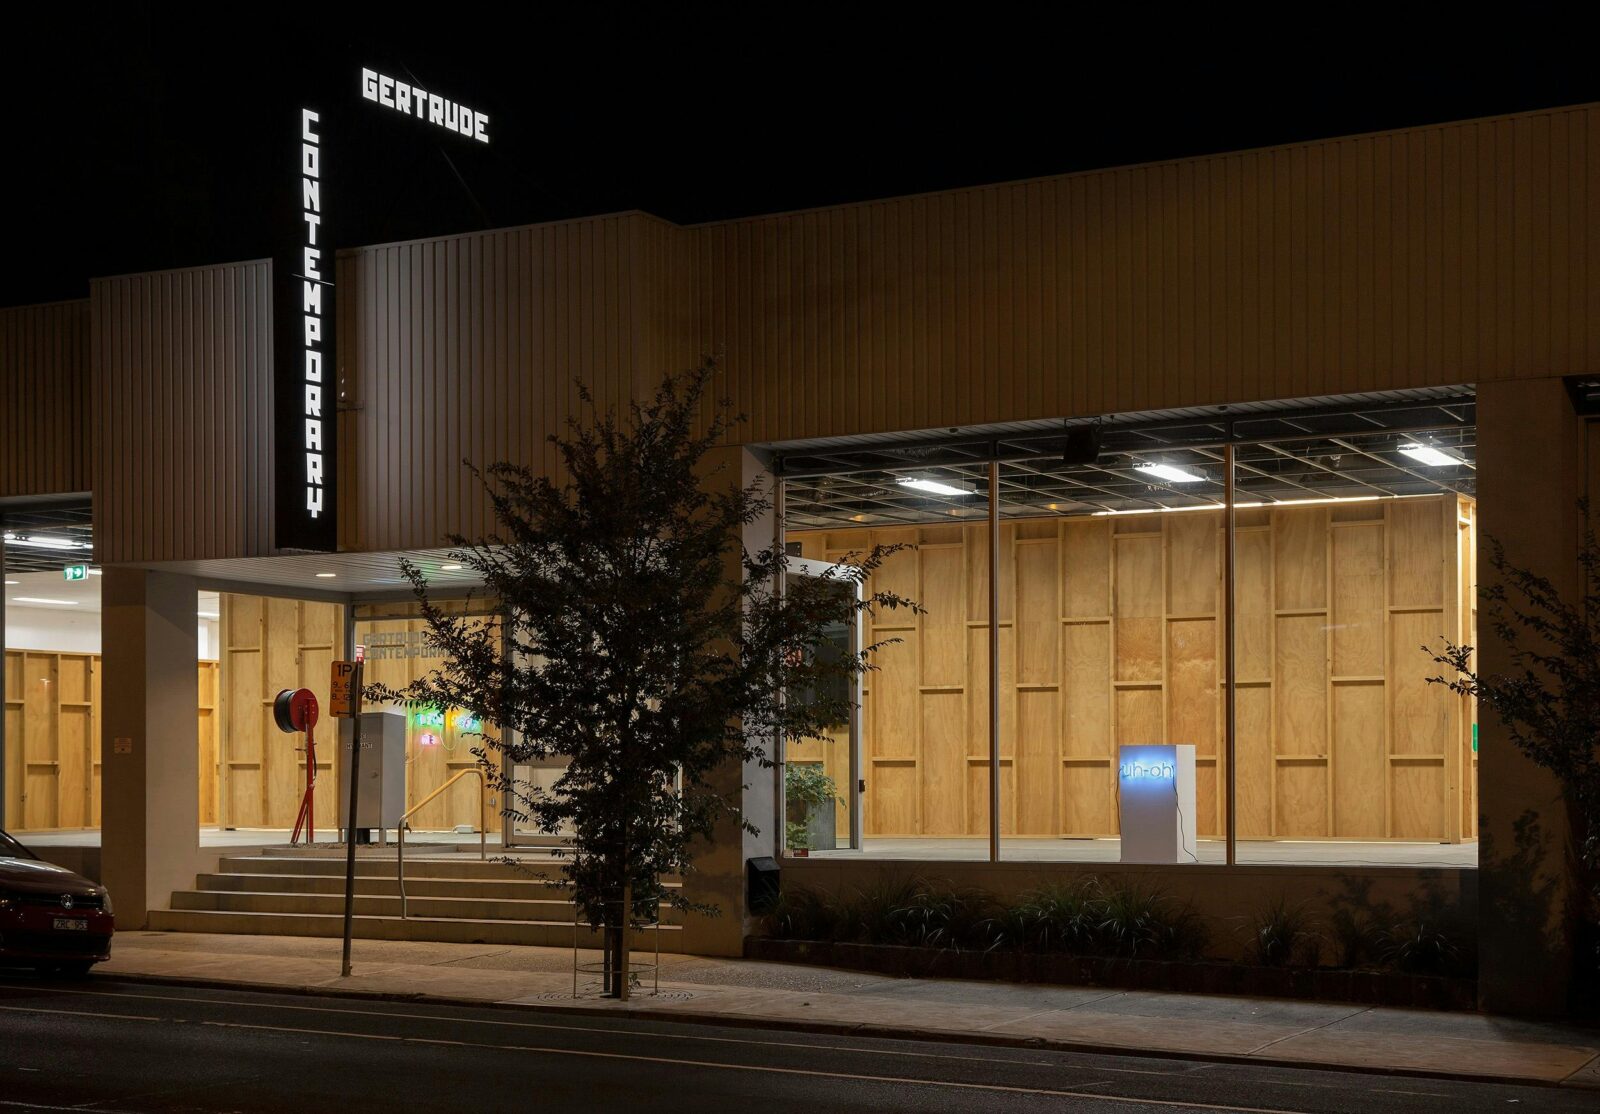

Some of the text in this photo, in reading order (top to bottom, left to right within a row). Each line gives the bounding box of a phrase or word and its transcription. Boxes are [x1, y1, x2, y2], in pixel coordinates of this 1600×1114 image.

[362, 67, 489, 144] GERTRUDE
[302, 108, 323, 518] CONTEMPORARY
[337, 664, 353, 677] 1P
[1121, 762, 1173, 778] uh-oh
